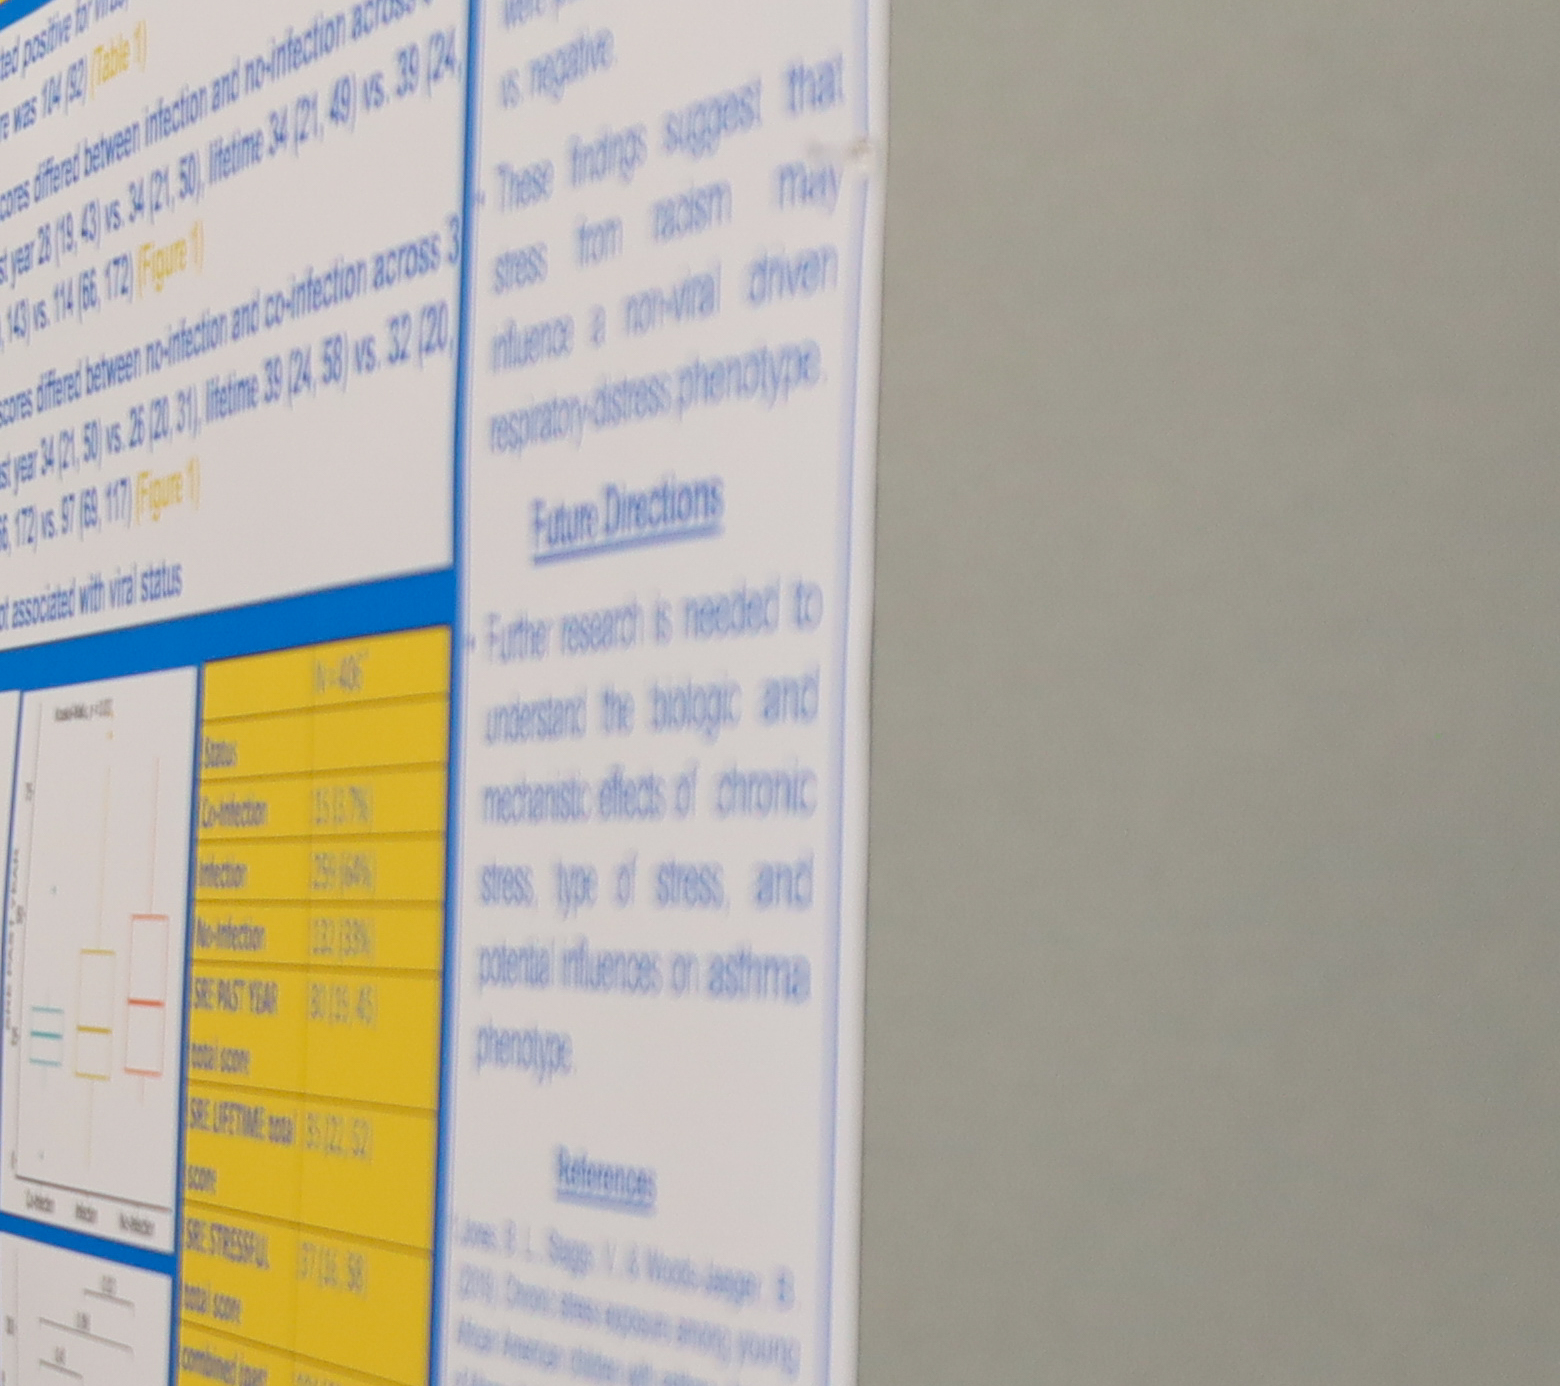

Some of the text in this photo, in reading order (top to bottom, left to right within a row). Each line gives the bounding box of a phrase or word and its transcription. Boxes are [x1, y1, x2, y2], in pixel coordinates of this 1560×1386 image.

[12, 95, 39, 134] was
[90, 31, 132, 101] (Table
[22, 10, 73, 80] positive
[32, 141, 82, 204] differed
[82, 119, 142, 179] between
[144, 82, 210, 148] infection
[210, 53, 241, 115] and
[243, 8, 349, 97] no-infection
[494, 51, 846, 213] These findings suggest that
[10, 238, 37, 291] year
[208, 124, 266, 187] lifetime
[492, 156, 845, 296] stress from racism may
[491, 242, 840, 374] influence a non-viral driven
[531, 470, 726, 552] Future Directions
[11, 575, 76, 631] associated
[78, 569, 106, 616] with
[108, 561, 139, 611] viral
[140, 557, 184, 603] status
[487, 576, 824, 664] Further research is needed to
[483, 686, 588, 749] understand
[601, 679, 636, 736] the
[760, 663, 822, 727] and
[714, 757, 819, 819] chronic
[753, 846, 815, 910] and
[560, 935, 664, 998] influences
[706, 939, 811, 1005] asthma
